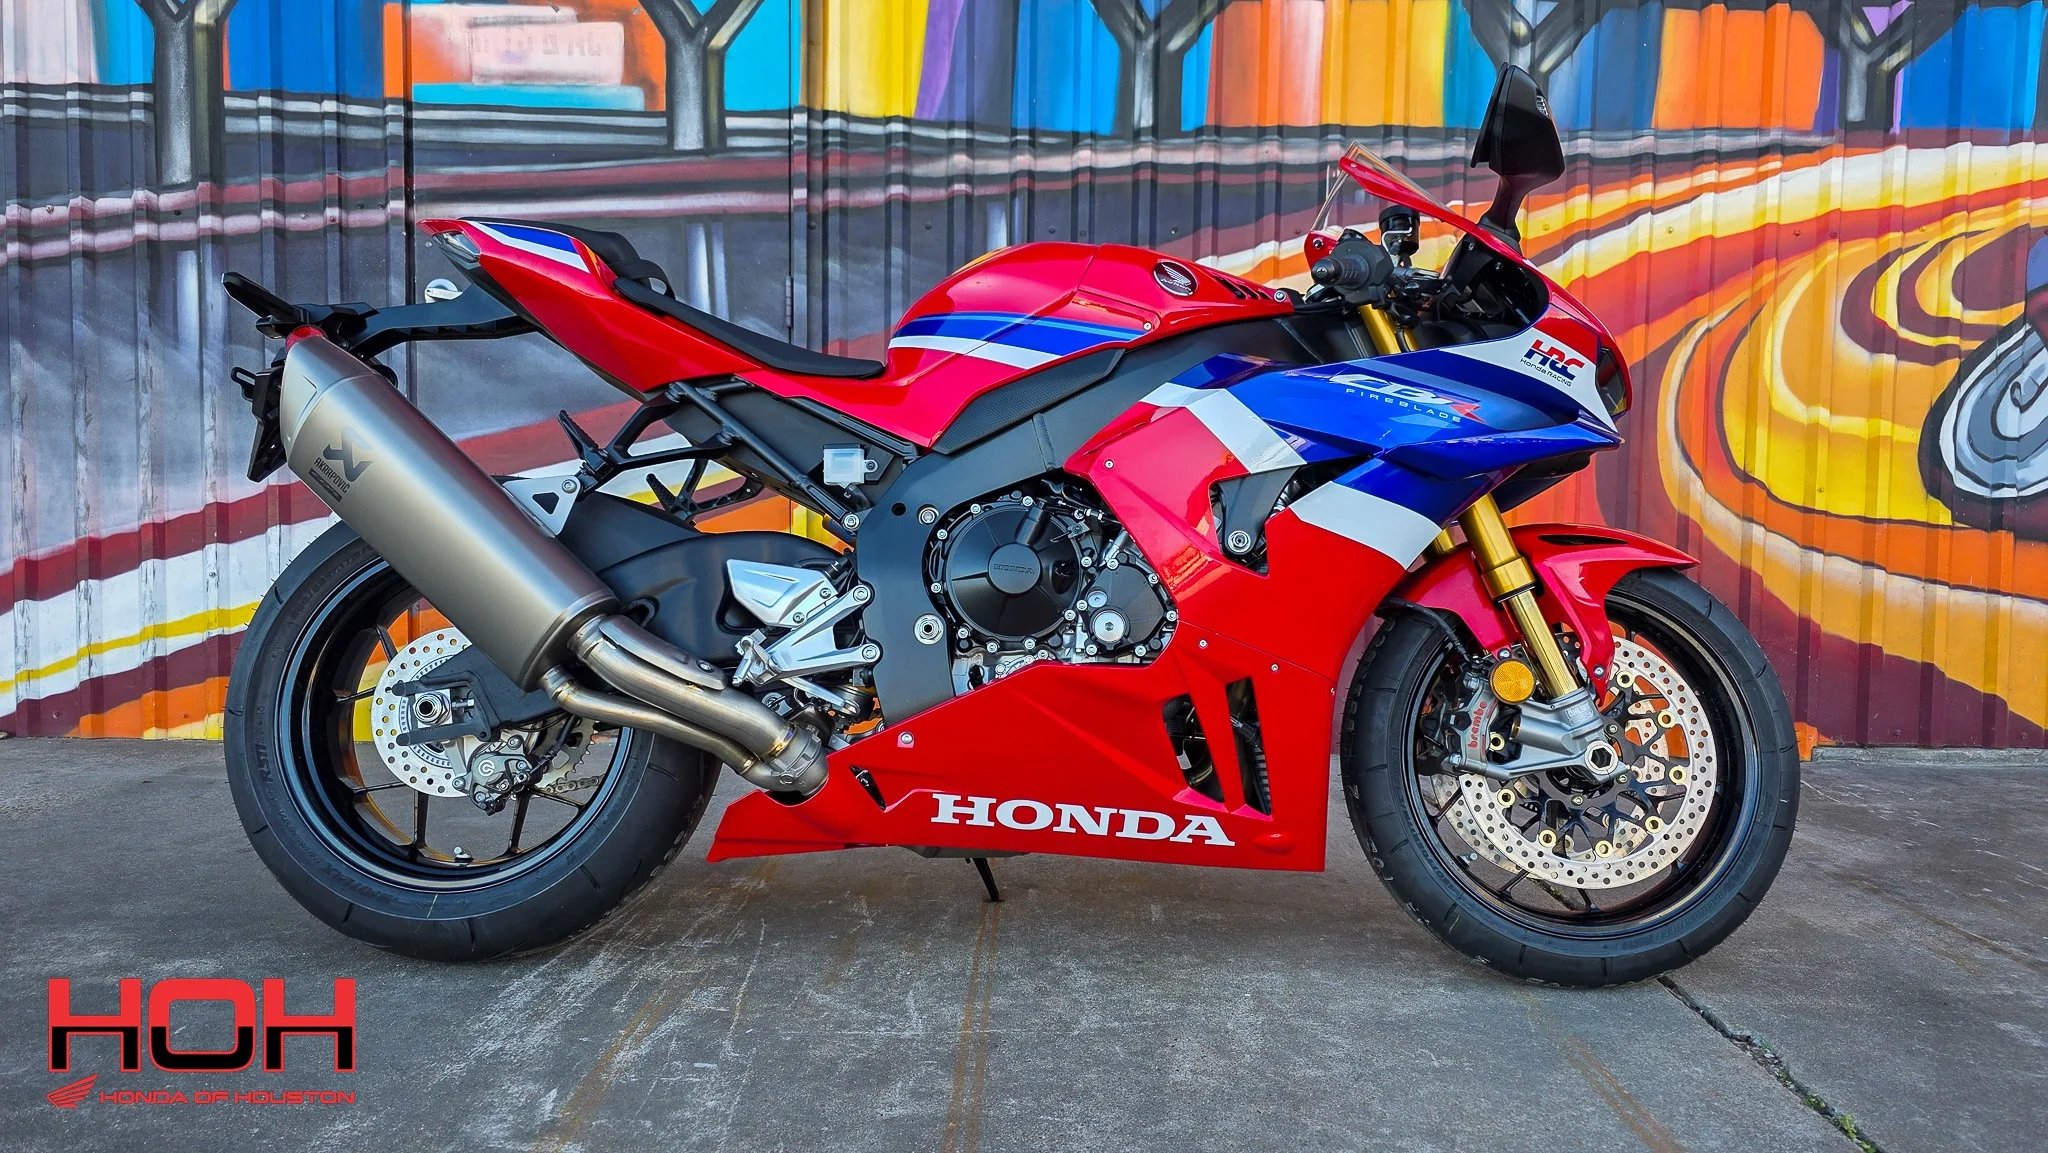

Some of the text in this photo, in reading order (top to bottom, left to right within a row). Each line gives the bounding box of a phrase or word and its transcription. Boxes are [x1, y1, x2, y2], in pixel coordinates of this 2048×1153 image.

[1519, 357, 1573, 388] Honda RACING
[1523, 338, 1586, 382] HRC
[1345, 388, 1462, 424] FIREBLADE
[993, 562, 1035, 575] HONDA
[1466, 701, 1488, 749] brembo
[930, 792, 1236, 847] HONDA
